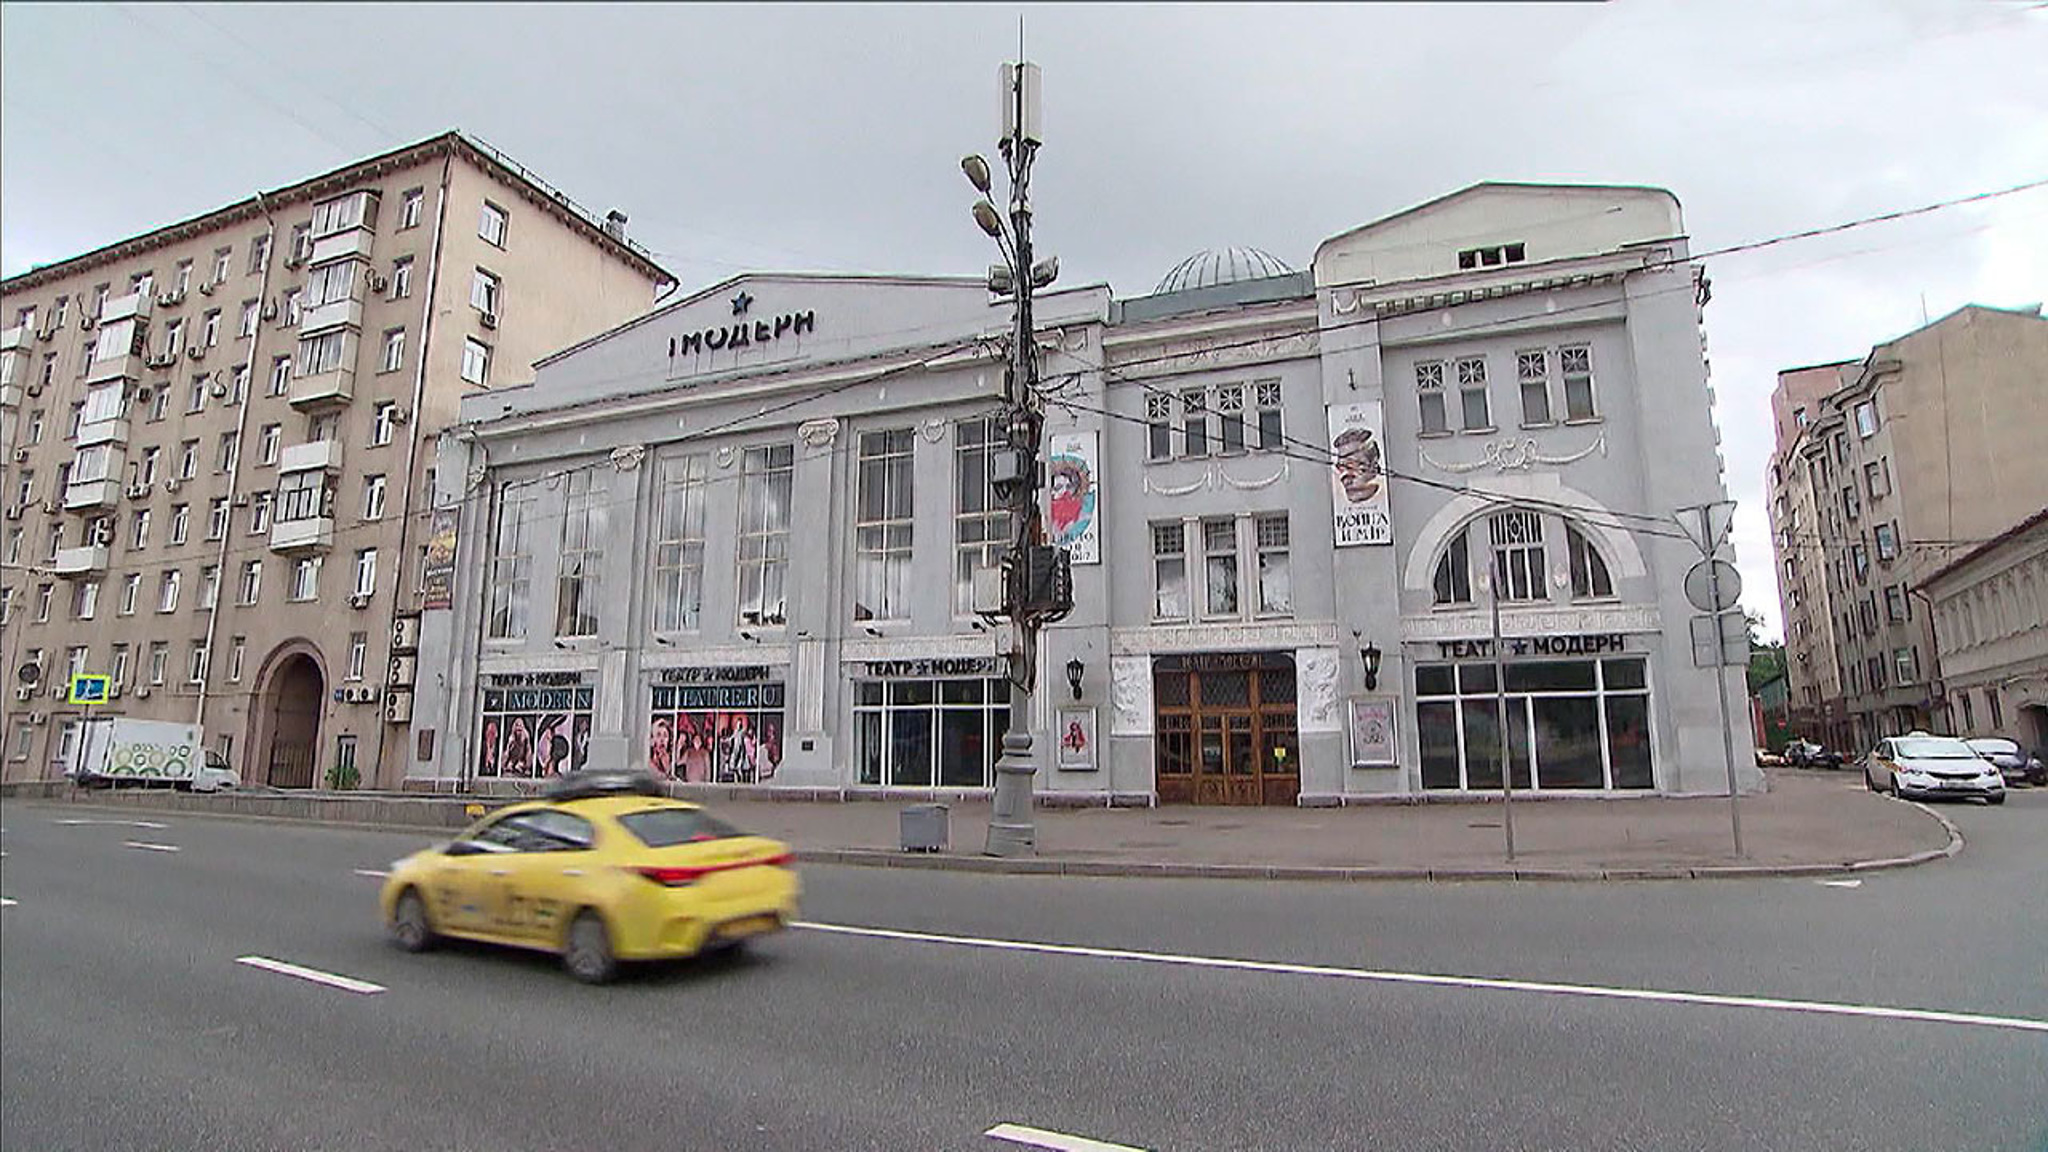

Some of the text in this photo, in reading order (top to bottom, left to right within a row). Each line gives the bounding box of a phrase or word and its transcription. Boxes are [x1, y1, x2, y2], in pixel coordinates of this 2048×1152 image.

[1534, 633, 1625, 656] МОДЕРН
[660, 666, 702, 682] ТЕАТР
[866, 658, 913, 676] ТЕАТР
[491, 672, 525, 686] ТЕАТР
